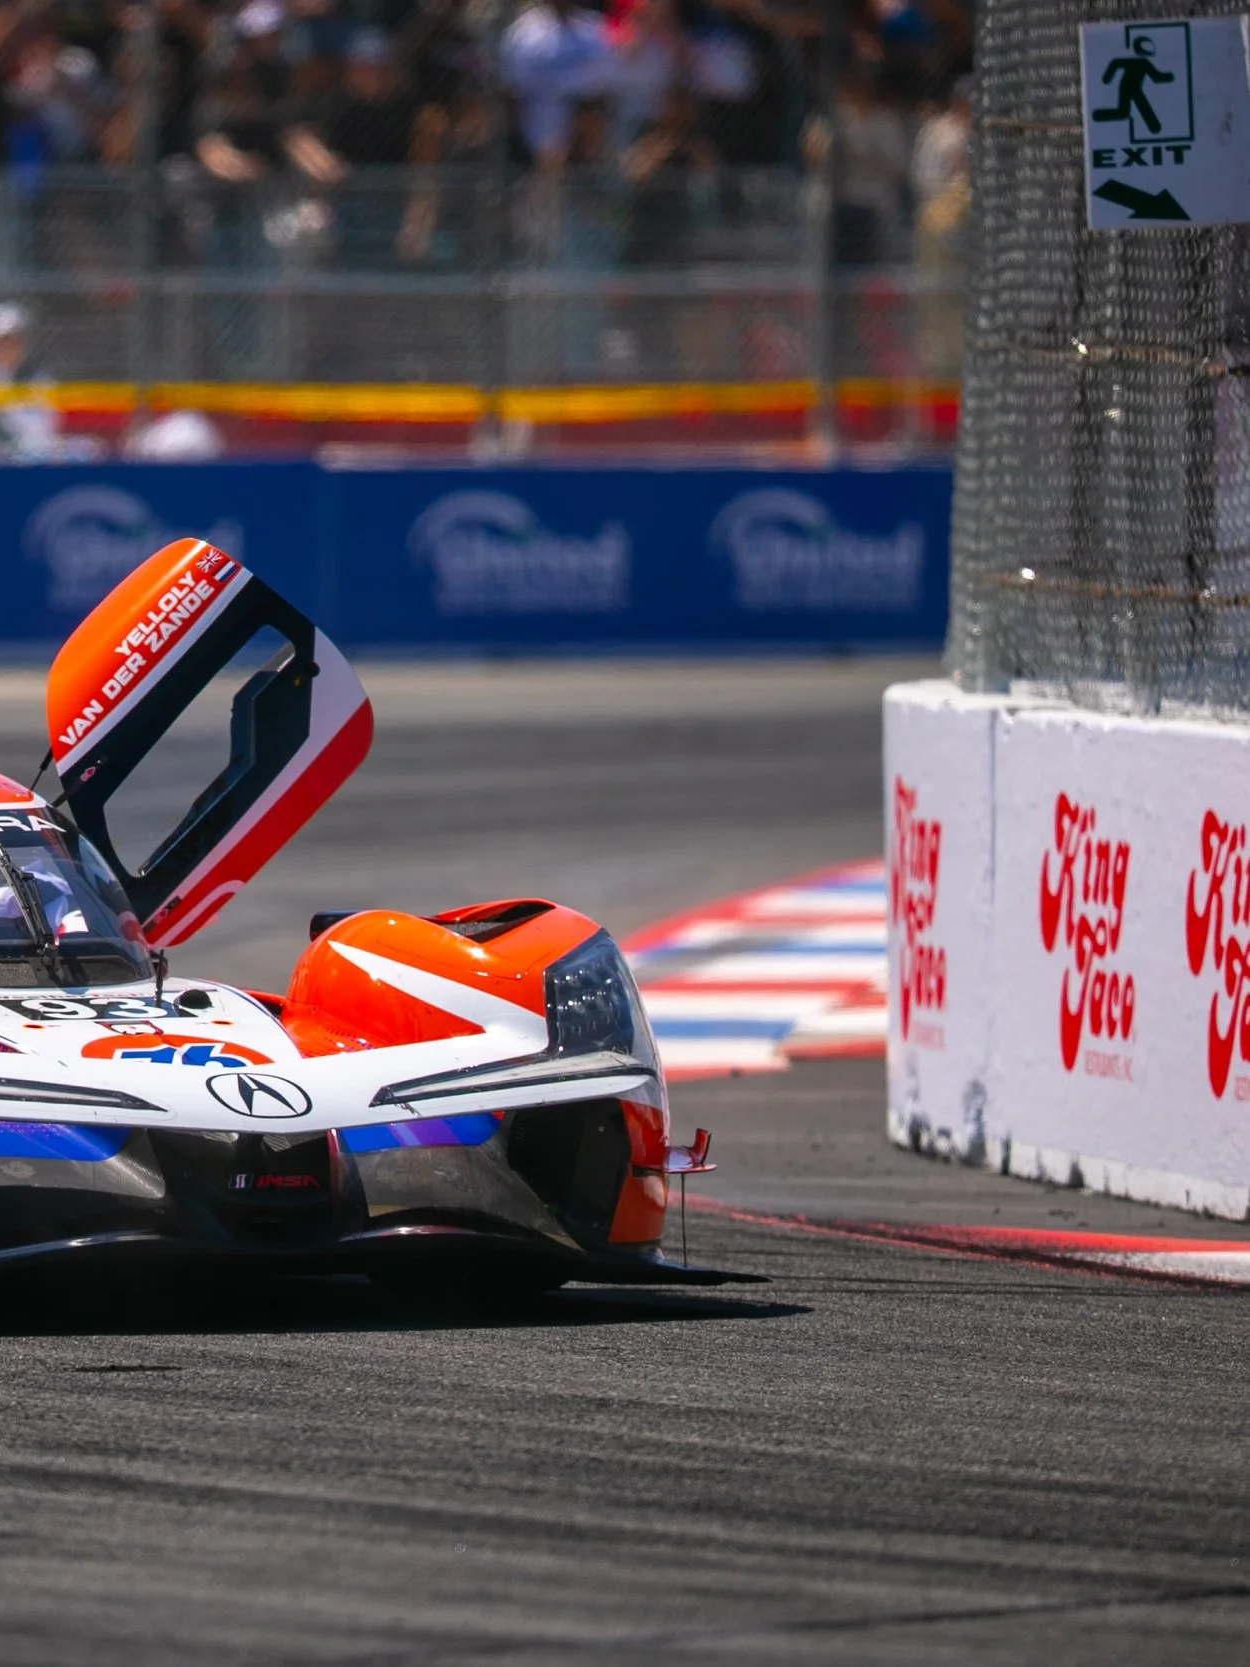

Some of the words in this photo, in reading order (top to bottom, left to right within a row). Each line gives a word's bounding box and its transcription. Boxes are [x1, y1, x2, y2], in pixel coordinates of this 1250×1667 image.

[1093, 145, 1192, 169] EXIT
[58, 699, 104, 746] VAN
[101, 652, 147, 700] DER
[143, 579, 215, 653] ZANDE
[114, 571, 195, 656] YELLOLY
[1039, 791, 1131, 954] King
[21, 998, 168, 1020] 93
[1060, 913, 1135, 1073] Taco
